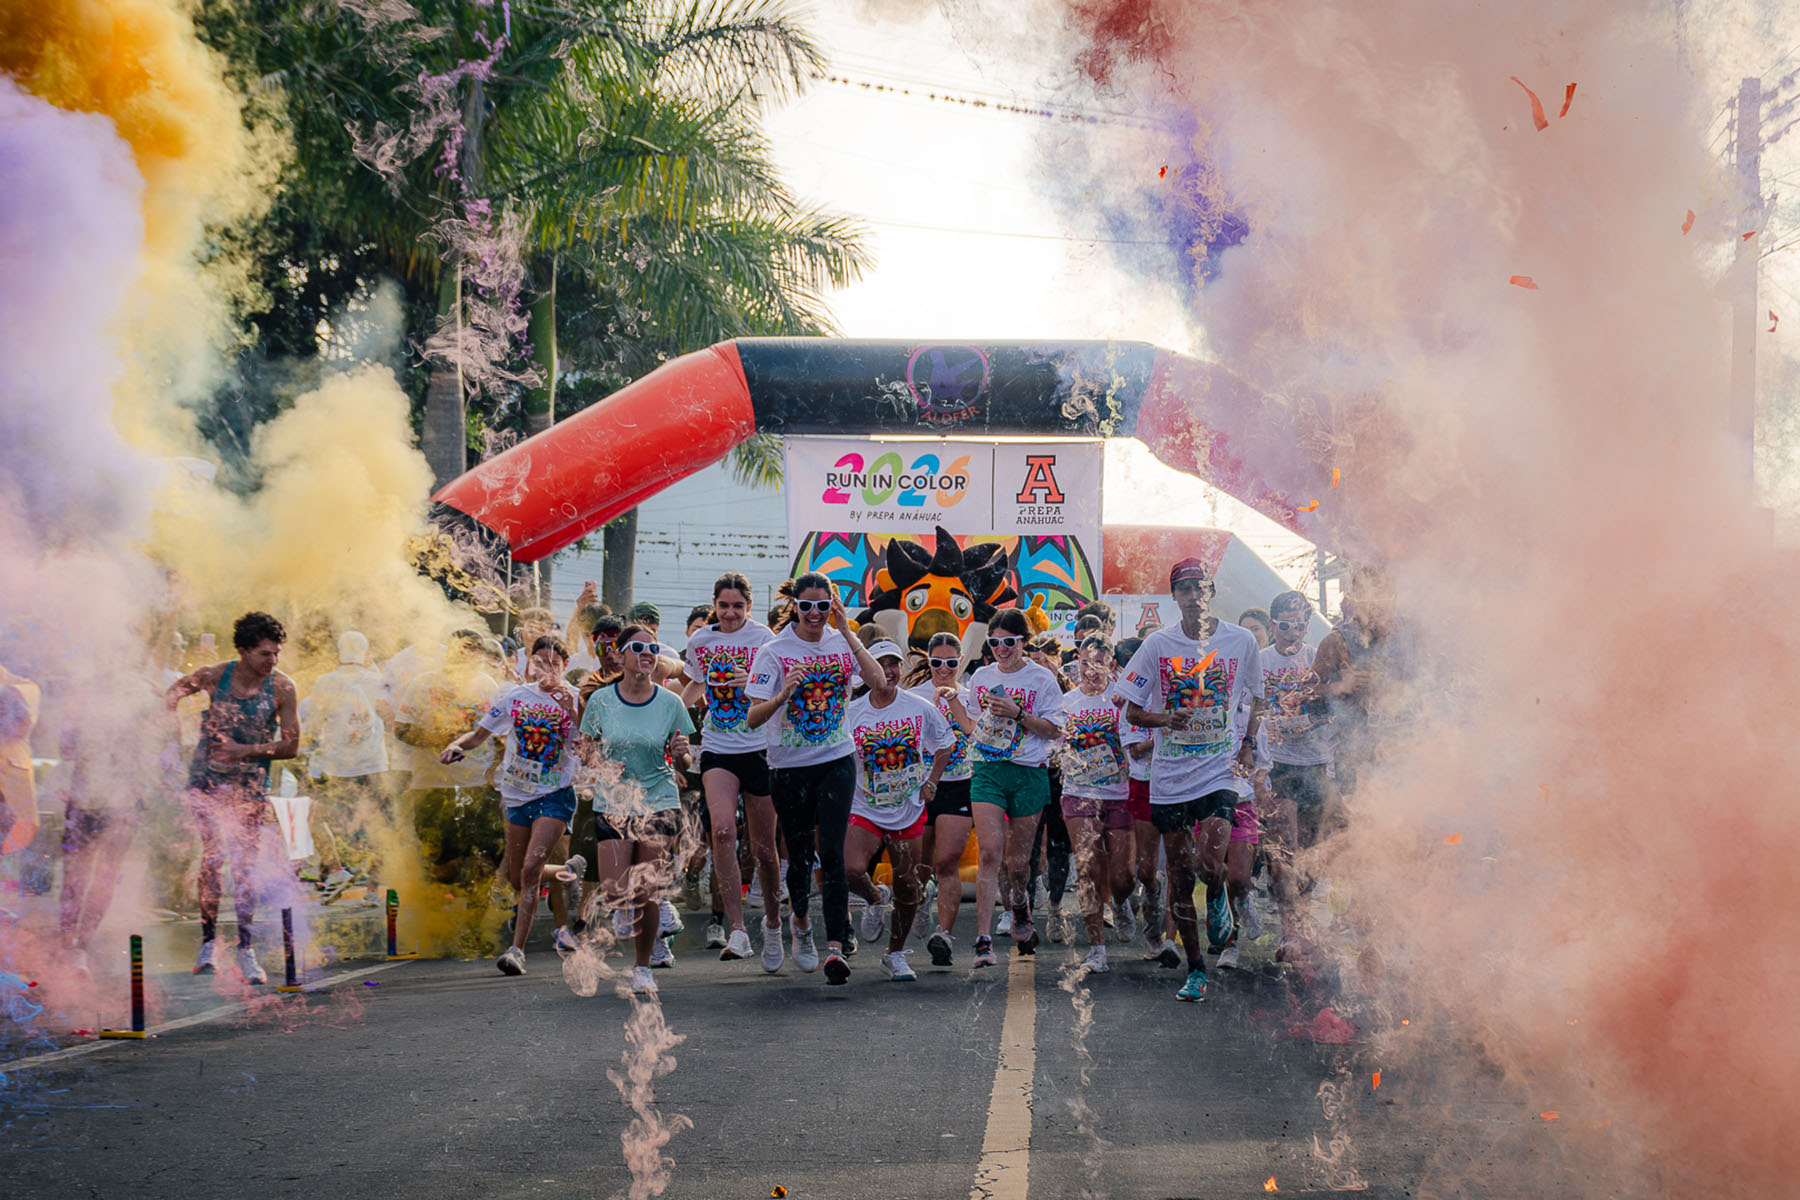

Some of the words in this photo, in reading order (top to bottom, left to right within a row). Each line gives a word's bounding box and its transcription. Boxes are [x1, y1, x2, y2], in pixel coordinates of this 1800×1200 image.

[822, 452, 971, 508] 2026
[826, 473, 867, 488] RUN
[873, 475, 892, 488] IN
[898, 475, 966, 490] COLOR
[1016, 455, 1065, 504] A
[867, 511, 894, 520] PREPA
[1018, 506, 1061, 515] PREPA
